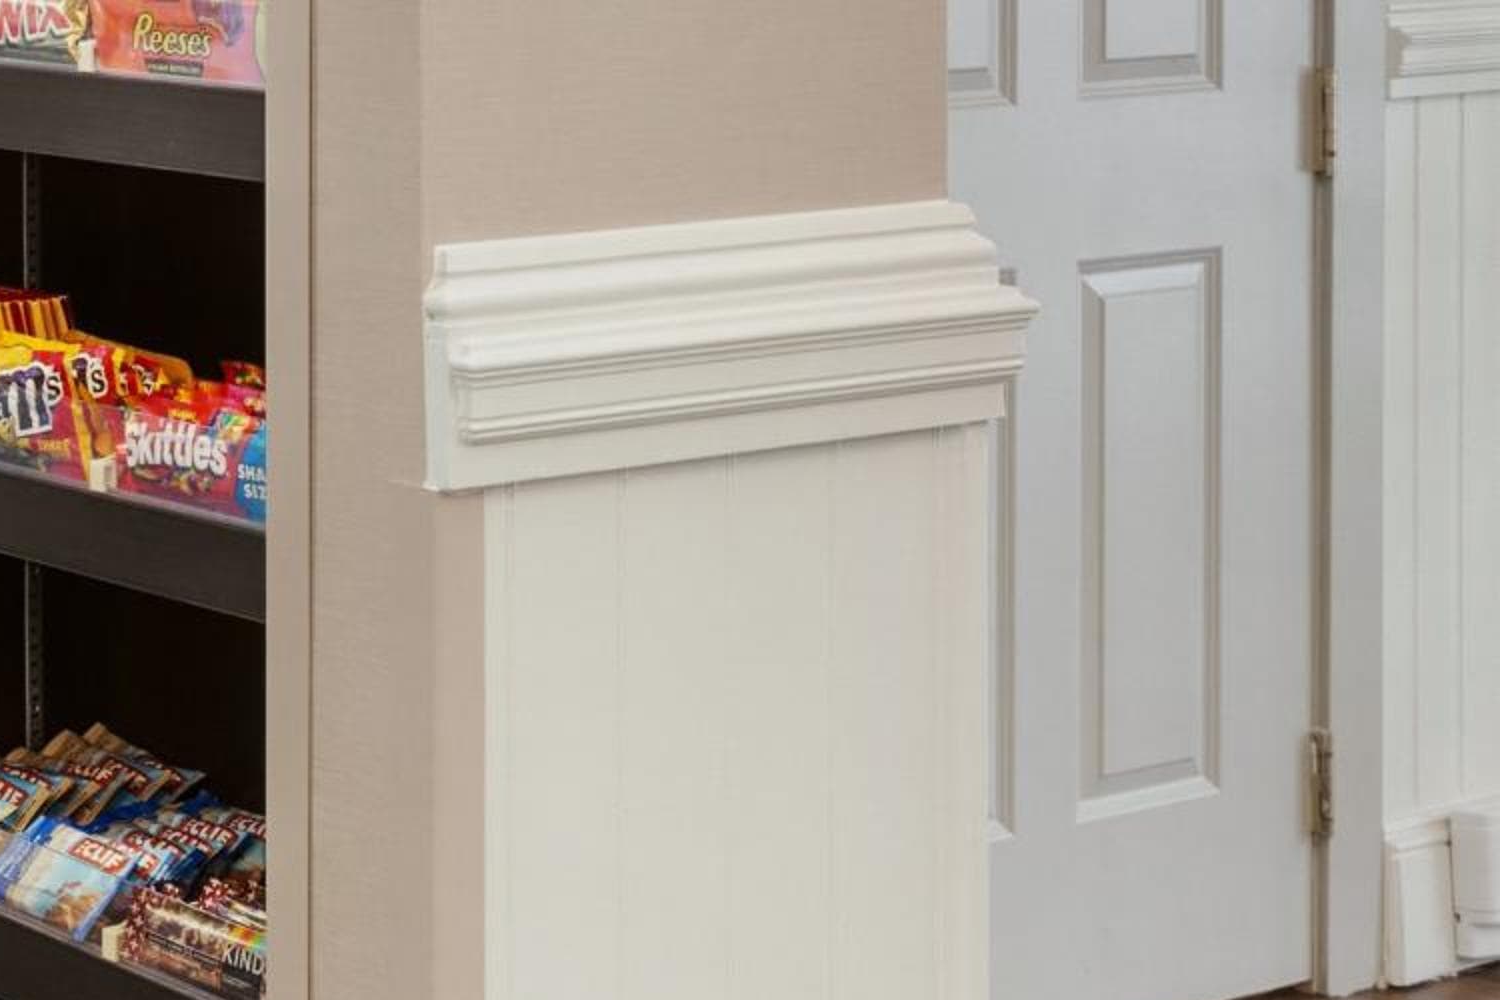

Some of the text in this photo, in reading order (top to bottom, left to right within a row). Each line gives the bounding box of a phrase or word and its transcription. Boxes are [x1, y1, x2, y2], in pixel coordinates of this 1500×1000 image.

[132, 12, 212, 56] Reese's
[127, 417, 228, 477] Skittles
[222, 942, 265, 975] KIND
